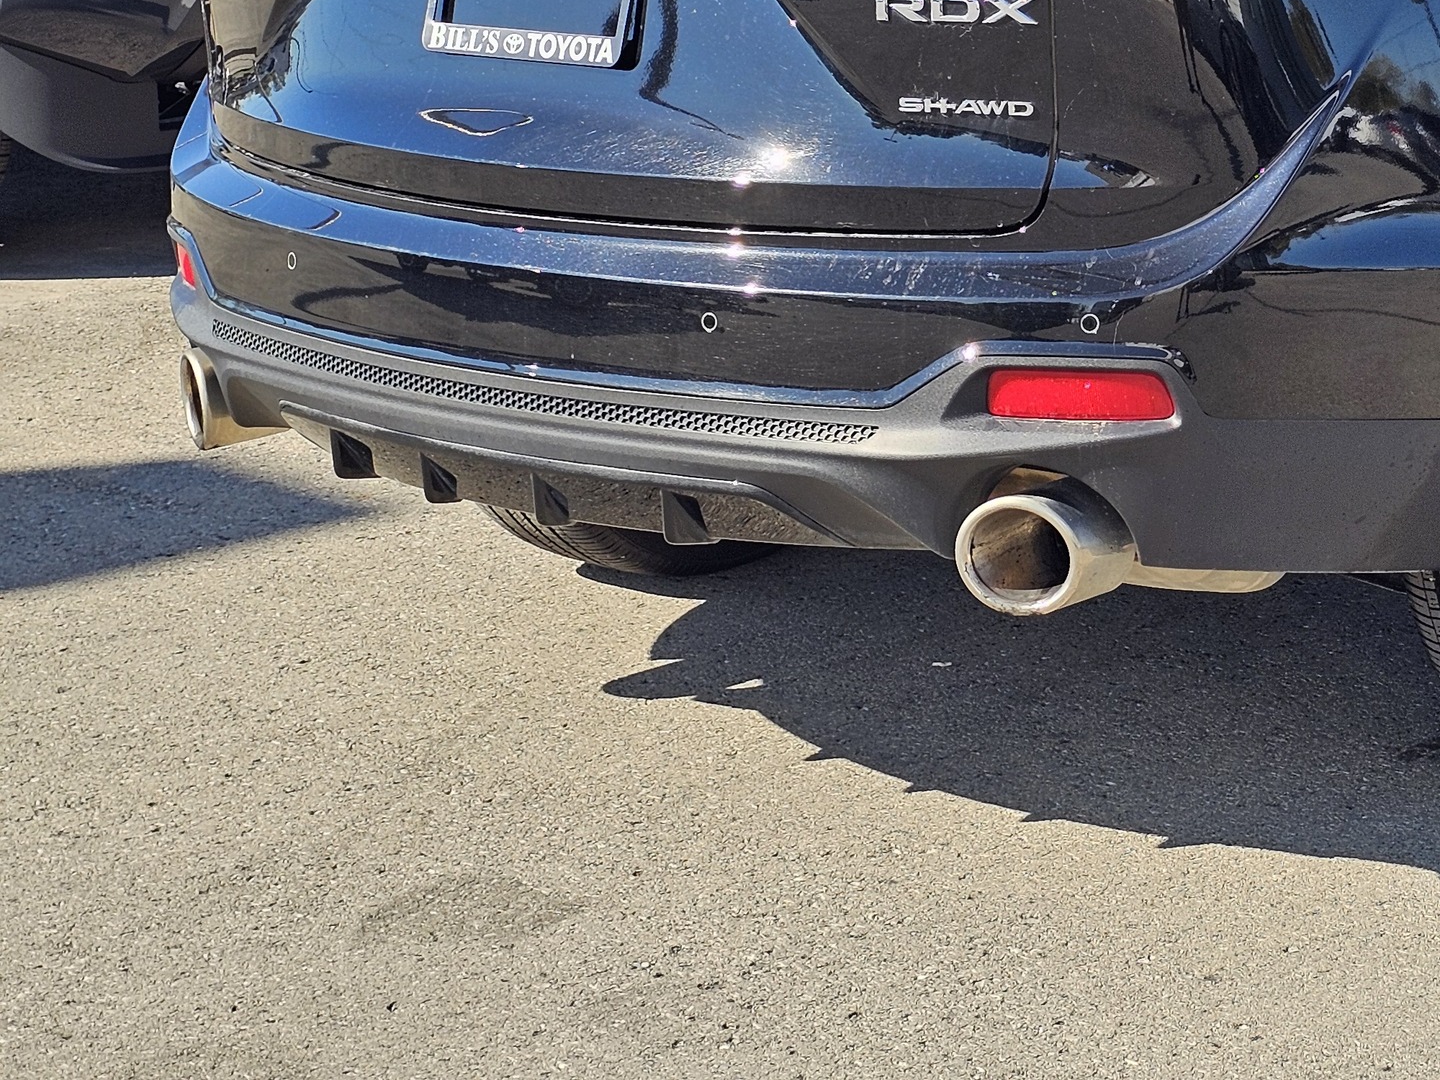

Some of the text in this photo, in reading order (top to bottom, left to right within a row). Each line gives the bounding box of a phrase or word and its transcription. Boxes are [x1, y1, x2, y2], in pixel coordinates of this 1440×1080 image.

[427, 23, 614, 64] BILL'S TOYOTA
[898, 96, 1034, 118] SH-AWD
